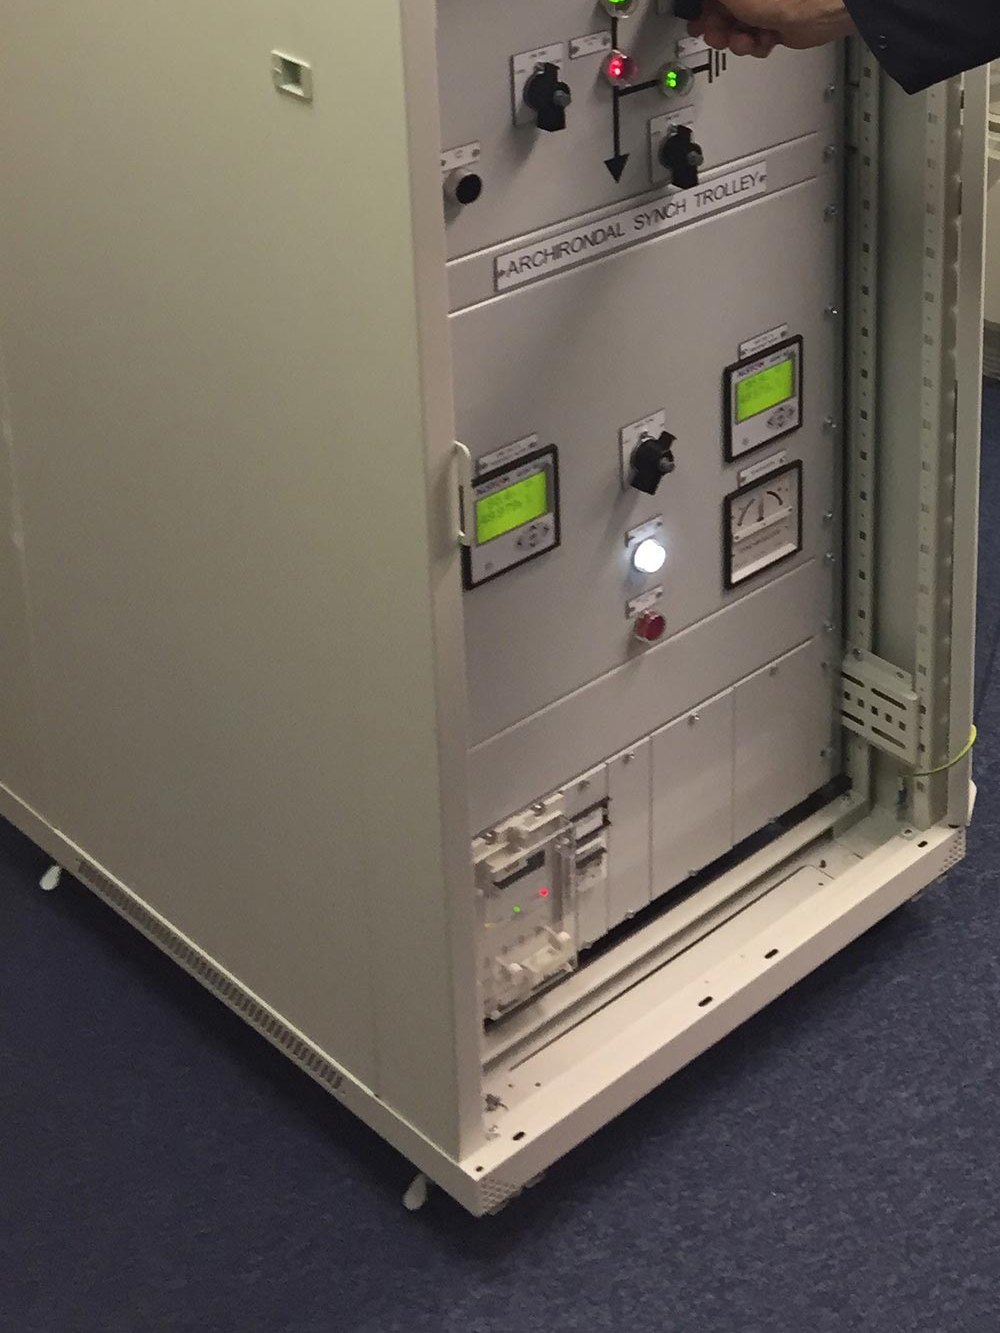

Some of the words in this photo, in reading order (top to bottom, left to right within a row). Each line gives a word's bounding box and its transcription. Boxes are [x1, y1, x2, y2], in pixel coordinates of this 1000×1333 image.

[504, 223, 626, 278] ARCHIRONDAL
[633, 198, 687, 231] SYNCH
[694, 173, 760, 208] TROLLEY
